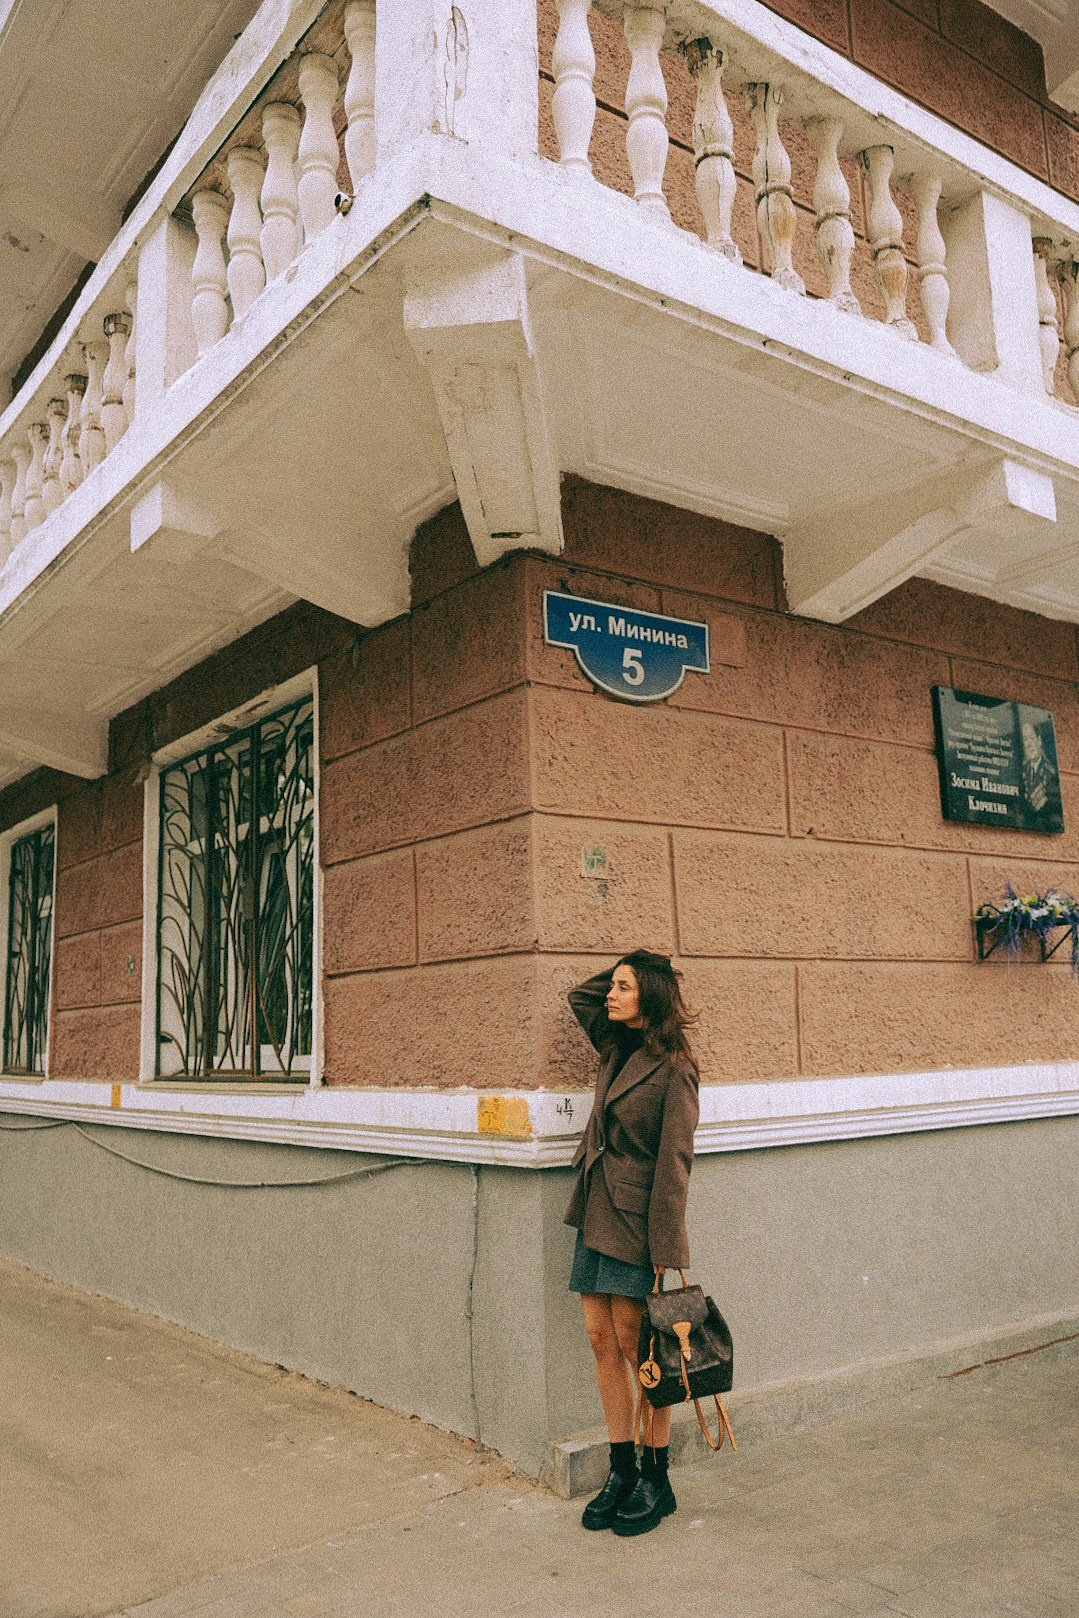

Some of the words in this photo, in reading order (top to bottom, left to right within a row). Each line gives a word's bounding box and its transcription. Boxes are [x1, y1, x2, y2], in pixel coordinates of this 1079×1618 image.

[569, 612, 602, 632] ул.
[608, 616, 688, 649] Минина
[622, 648, 645, 686] 5
[951, 772, 981, 791] Зосима
[981, 777, 1020, 797] Иванович
